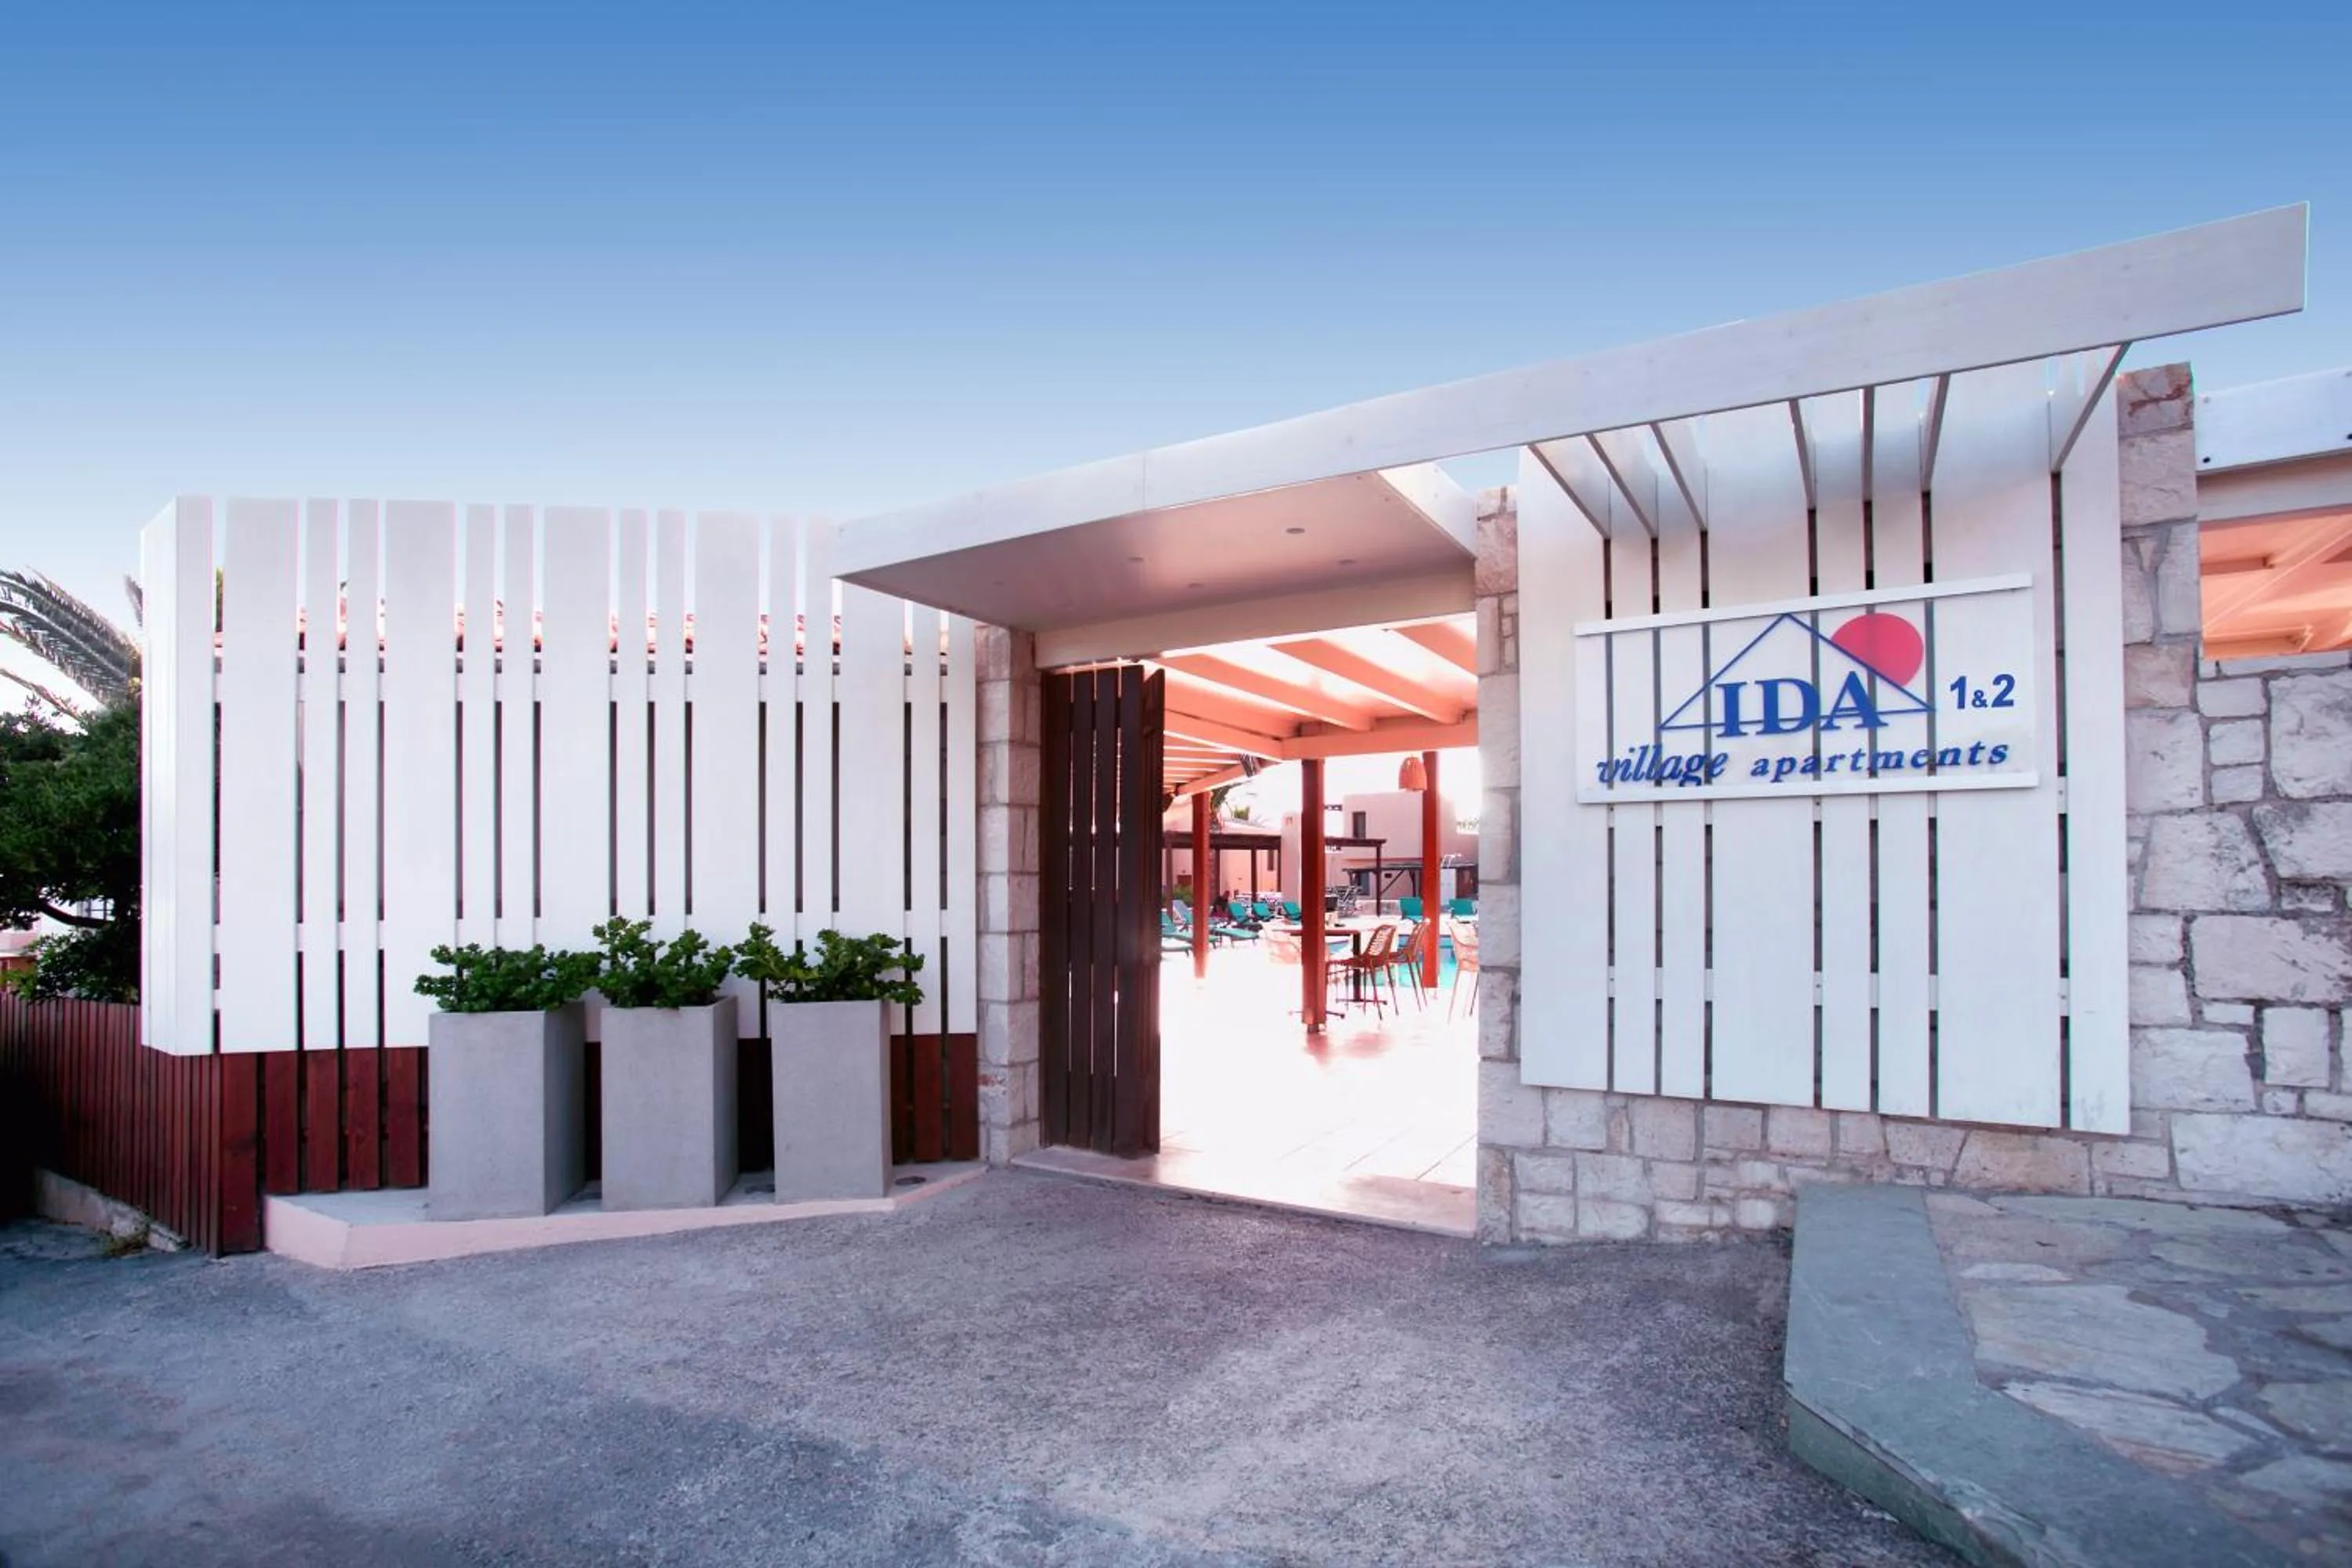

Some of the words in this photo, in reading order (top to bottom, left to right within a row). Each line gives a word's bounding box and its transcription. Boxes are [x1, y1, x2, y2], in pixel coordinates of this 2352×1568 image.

[1715, 670, 1889, 738] IDA
[1950, 674, 2016, 710] 1&2
[1596, 745, 1730, 786] village
[1751, 741, 2009, 783] apartments
